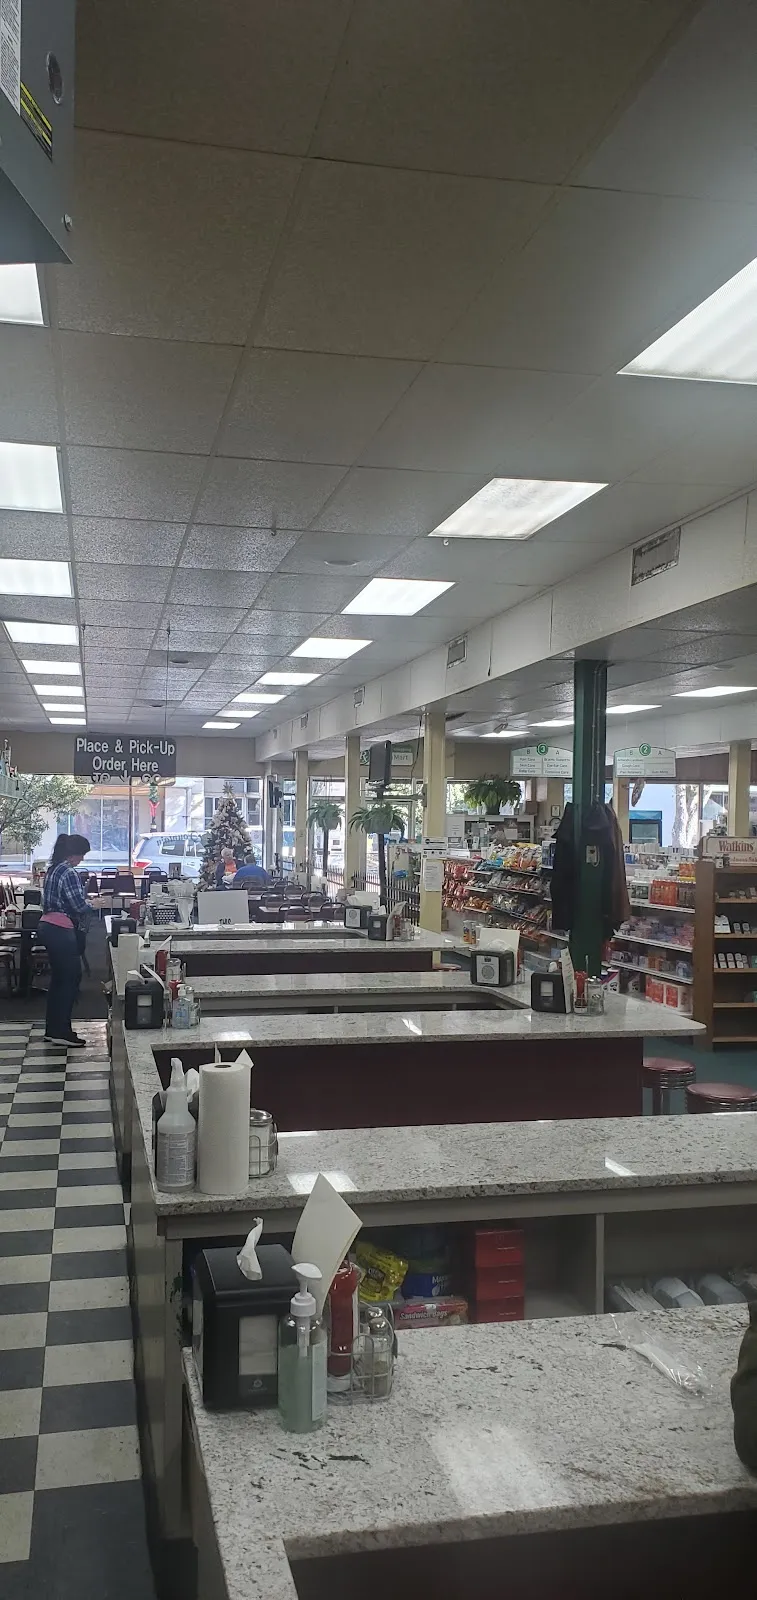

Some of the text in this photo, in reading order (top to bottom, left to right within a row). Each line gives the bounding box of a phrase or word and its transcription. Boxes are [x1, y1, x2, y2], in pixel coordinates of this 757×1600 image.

[76, 738, 175, 756] Place & Pick-Up
[92, 756, 159, 772] Order Here
[718, 840, 754, 852] Watkins
[400, 1309, 448, 1320] Sandwich Bags
